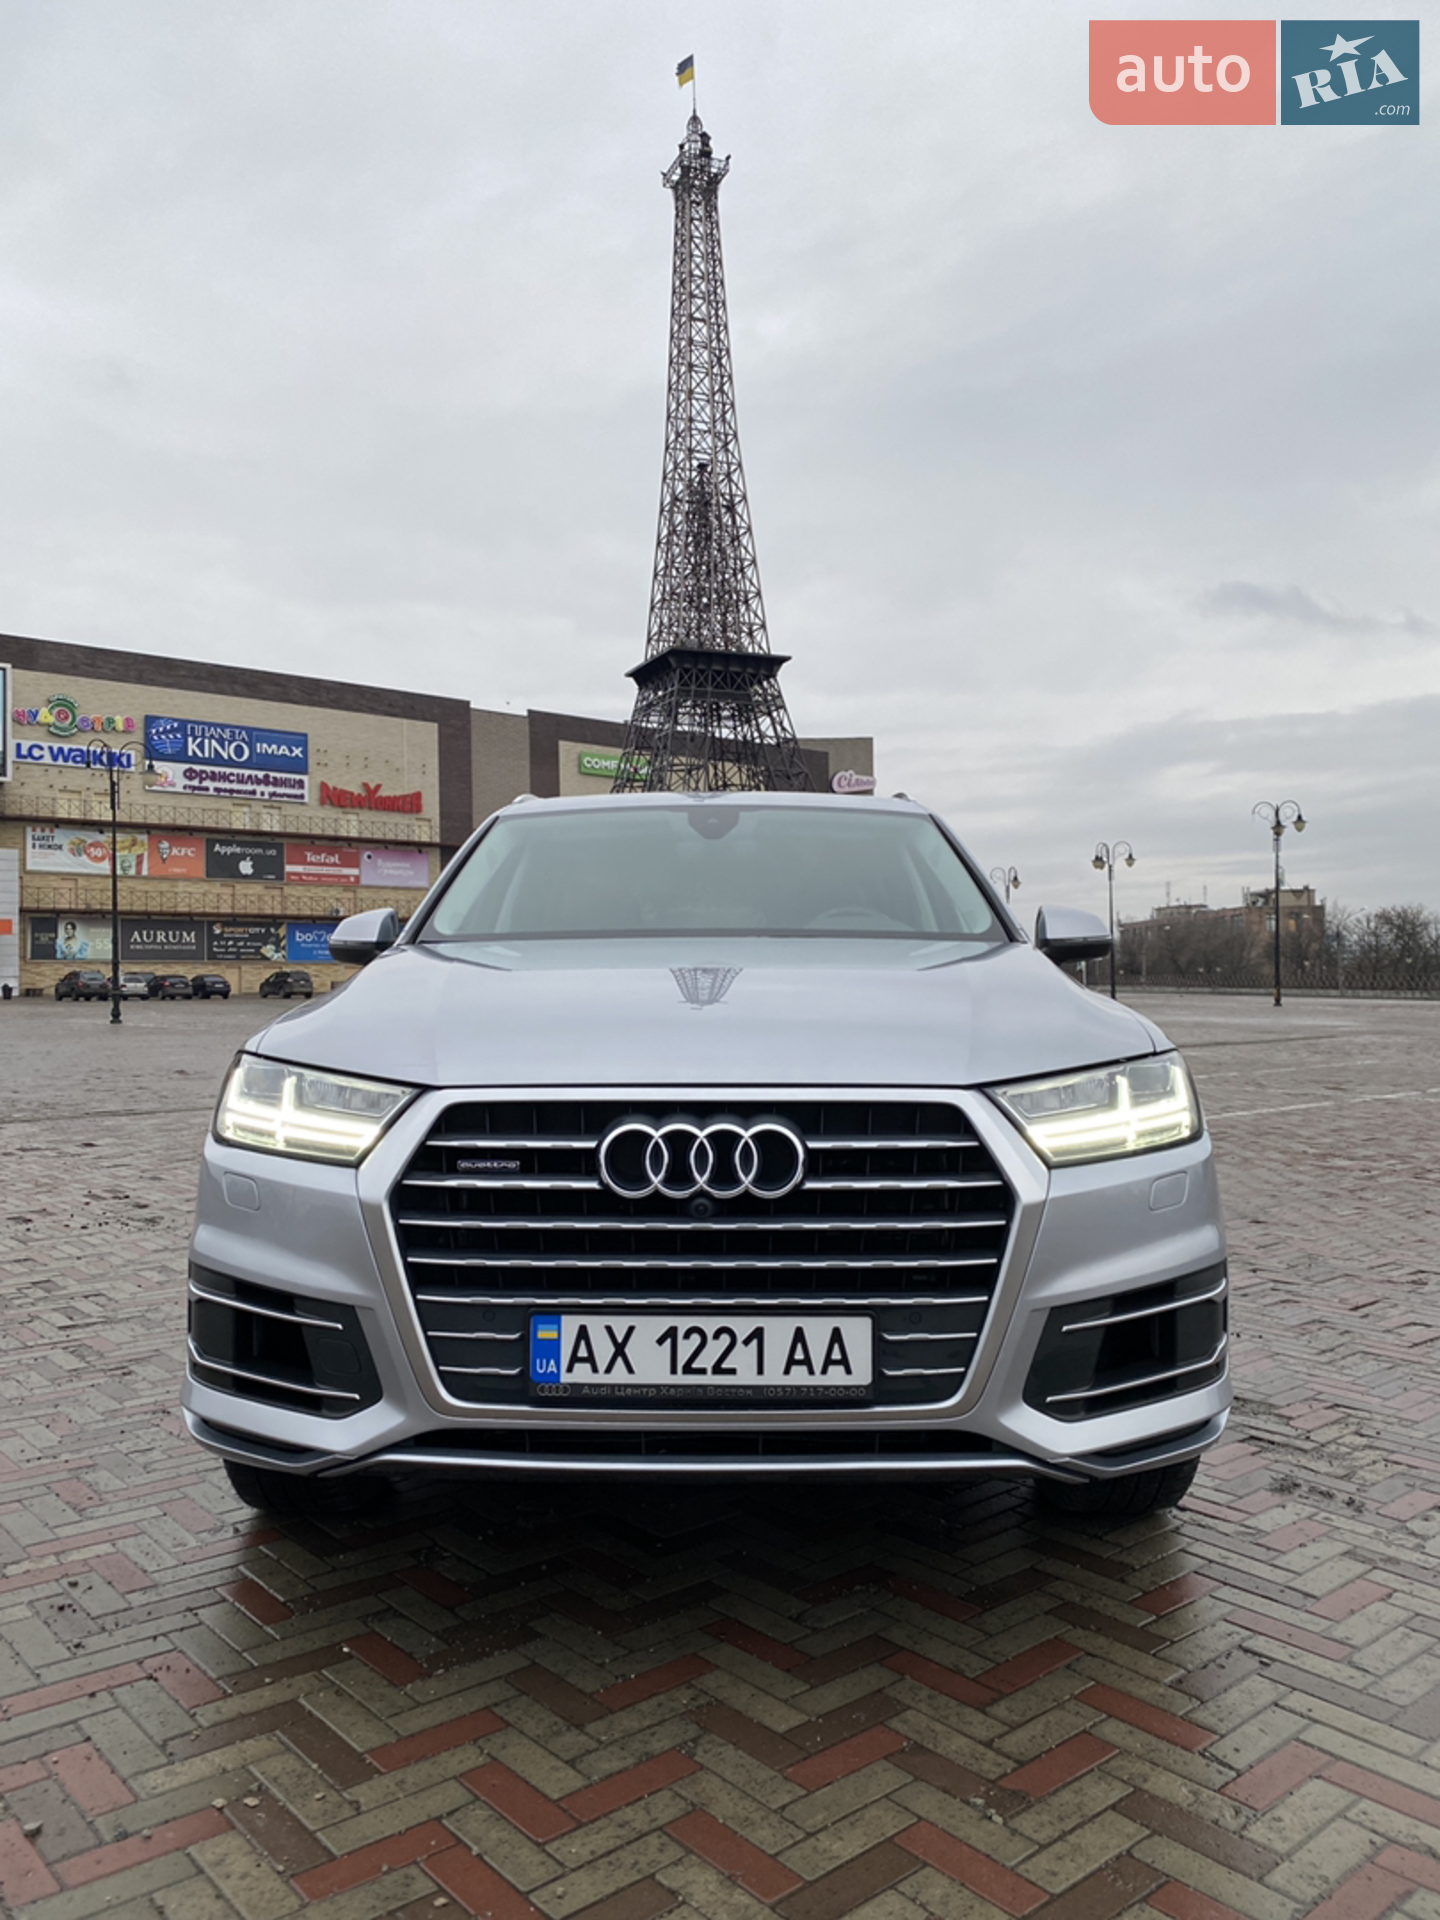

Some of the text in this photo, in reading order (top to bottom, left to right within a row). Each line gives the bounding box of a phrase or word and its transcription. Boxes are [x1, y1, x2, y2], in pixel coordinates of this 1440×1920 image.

[16, 742, 45, 761] LC
[187, 736, 303, 762] KINO IMAX
[183, 767, 305, 790] Франсильвания
[171, 847, 196, 856] KFC
[213, 843, 277, 856] Appleroom.ua
[304, 851, 341, 864] Tefal
[130, 930, 196, 943] AURUM
[460, 1161, 517, 1169] quattro
[536, 1324, 852, 1376] UA AX 1221 AA
[581, 1385, 612, 1395] Audi
[615, 1385, 657, 1397] Центр
[763, 1387, 797, 1397] (057)
[800, 1387, 866, 1397] 717-00-00
